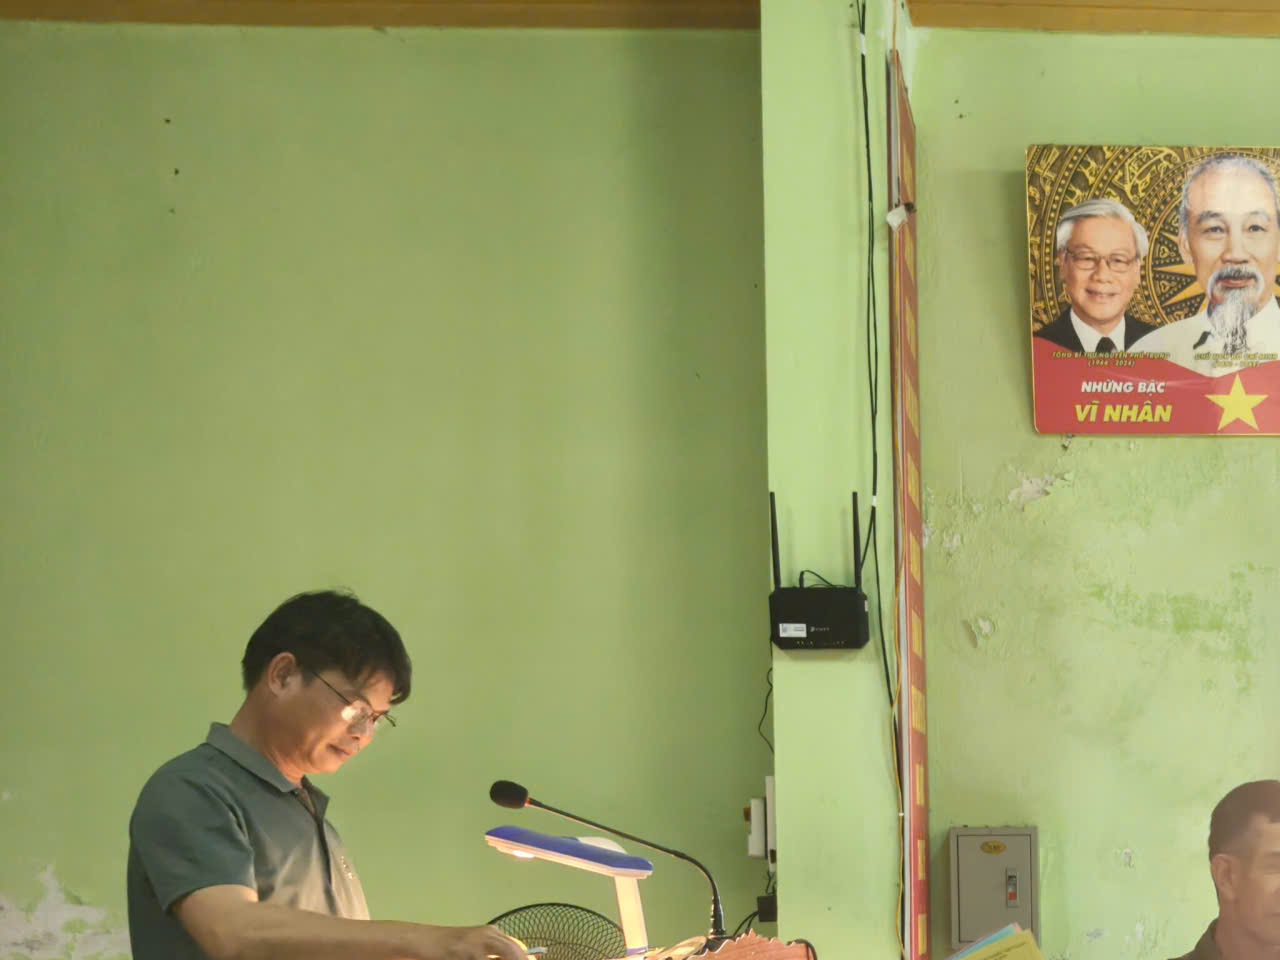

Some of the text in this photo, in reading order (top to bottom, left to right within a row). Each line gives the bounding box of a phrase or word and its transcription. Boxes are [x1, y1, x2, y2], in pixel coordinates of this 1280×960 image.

[1081, 379, 1167, 396] NHỮNG BẬC
[1074, 400, 1173, 423] VĨ NHÂN
